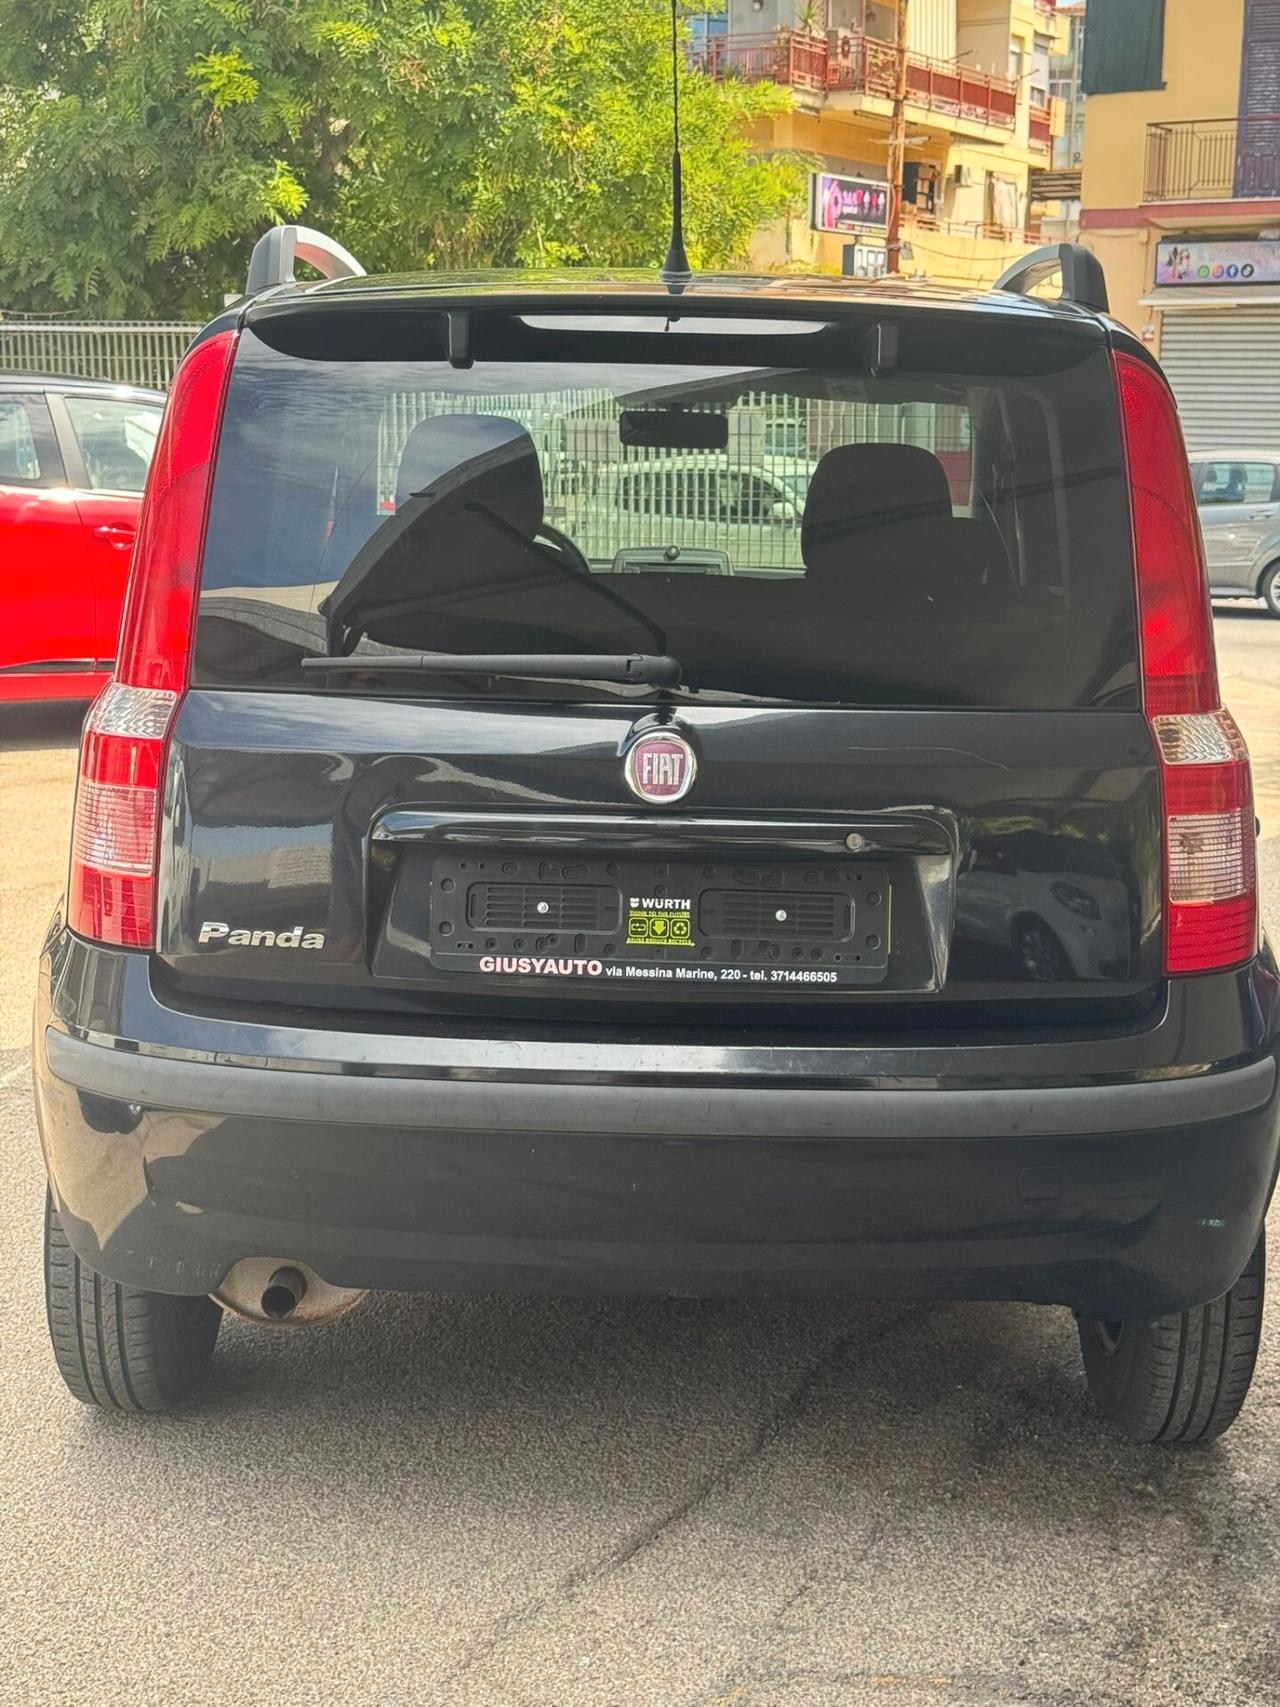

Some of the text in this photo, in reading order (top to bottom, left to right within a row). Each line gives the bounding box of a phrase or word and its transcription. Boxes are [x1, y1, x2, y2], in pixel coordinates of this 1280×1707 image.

[642, 753, 684, 785] FIAT
[198, 921, 326, 949] Panda
[479, 956, 603, 976] GIUSYAUTO
[605, 966, 623, 977] via
[625, 966, 673, 978] Messina
[675, 967, 718, 981] Marine,
[720, 968, 741, 980] 220
[749, 970, 768, 981] tel.
[770, 970, 838, 983] 3714466505
